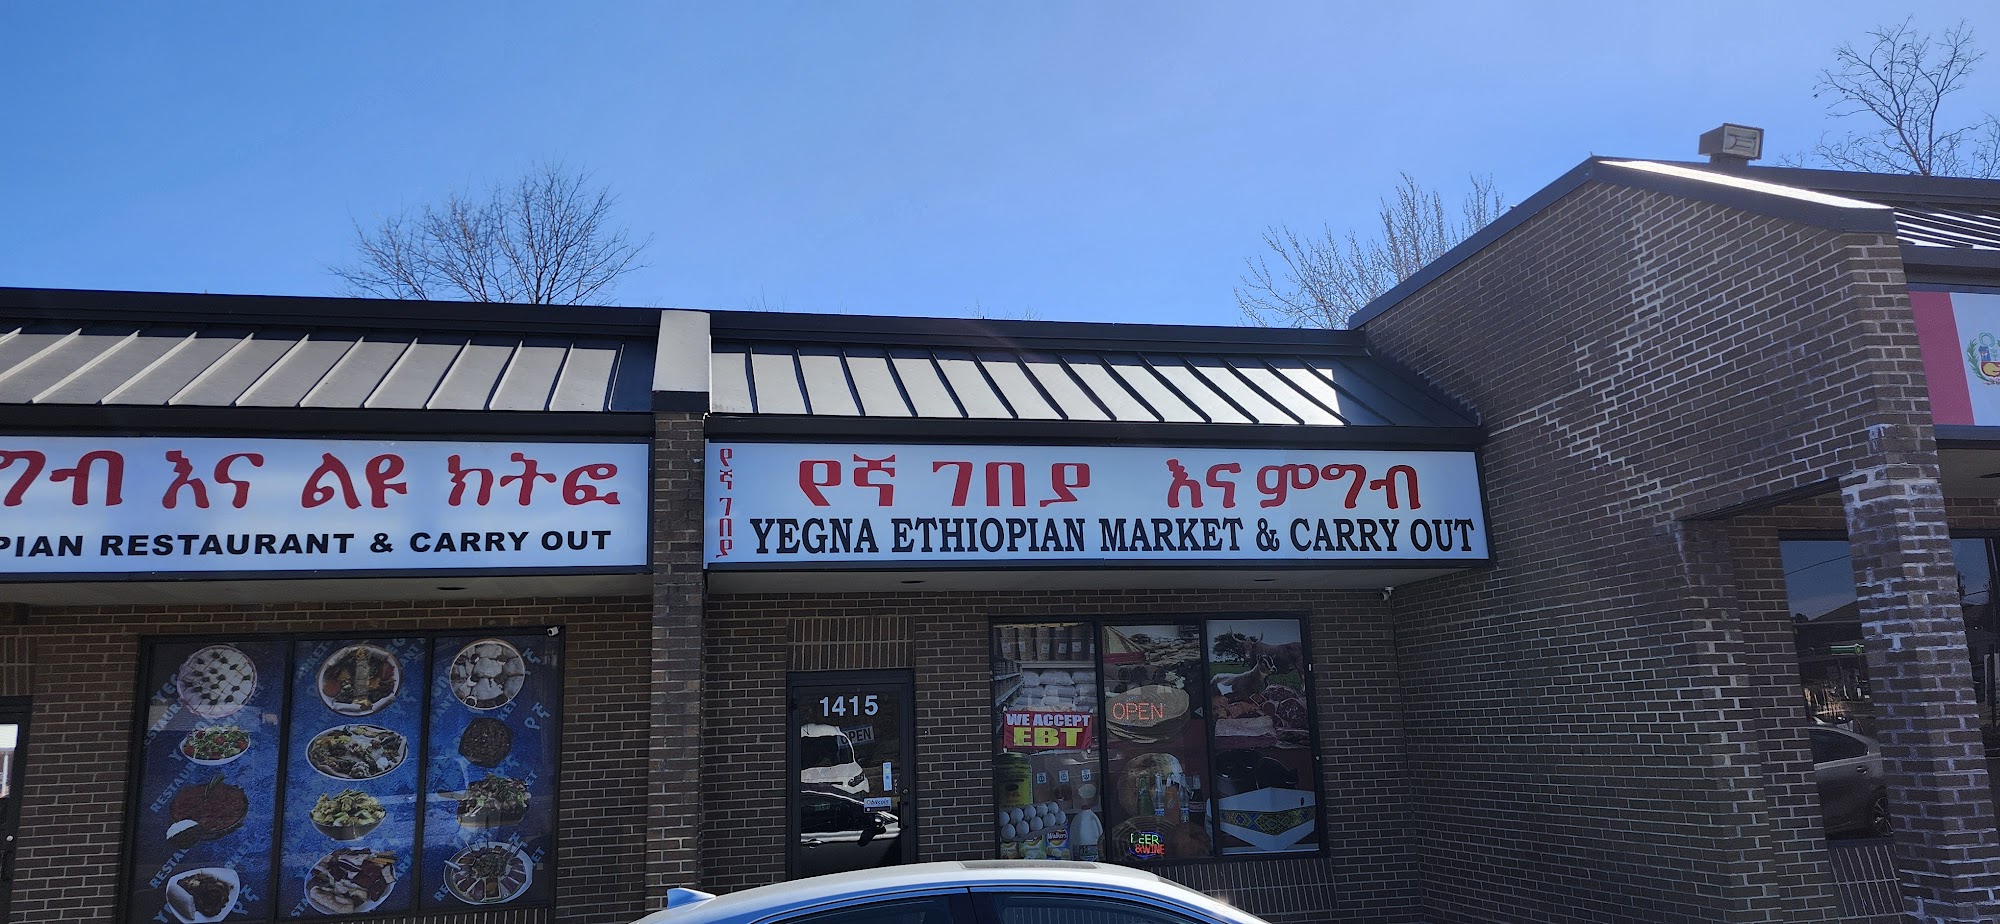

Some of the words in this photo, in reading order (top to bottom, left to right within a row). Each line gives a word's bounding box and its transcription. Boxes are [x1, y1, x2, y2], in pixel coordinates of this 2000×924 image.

[162, 450, 264, 509] እና
[301, 453, 407, 509] ልዩ
[448, 452, 620, 506] ክትፎ
[799, 454, 896, 507] የኛ
[933, 461, 1090, 508] ገበያ
[1166, 458, 1241, 509] እና
[1257, 463, 1421, 510] ምግብ
[100, 531, 355, 557] RESTAURANT
[369, 532, 394, 553] &
[409, 530, 530, 553] CARRY
[541, 529, 613, 551] OUT
[749, 517, 880, 554] YEGNA
[890, 516, 1086, 554] ETHIOPIAN
[1099, 517, 1244, 553] MARKET
[1256, 517, 1280, 553] &
[1290, 517, 1400, 553] CARRY
[1410, 518, 1475, 553] OUT
[819, 694, 879, 717] 1415
[1112, 702, 1165, 721] OPEN
[1006, 713, 1030, 726] WE
[1032, 714, 1090, 727] ACCEPT
[840, 727, 872, 745] OPEN
[1013, 726, 1083, 747] EBT
